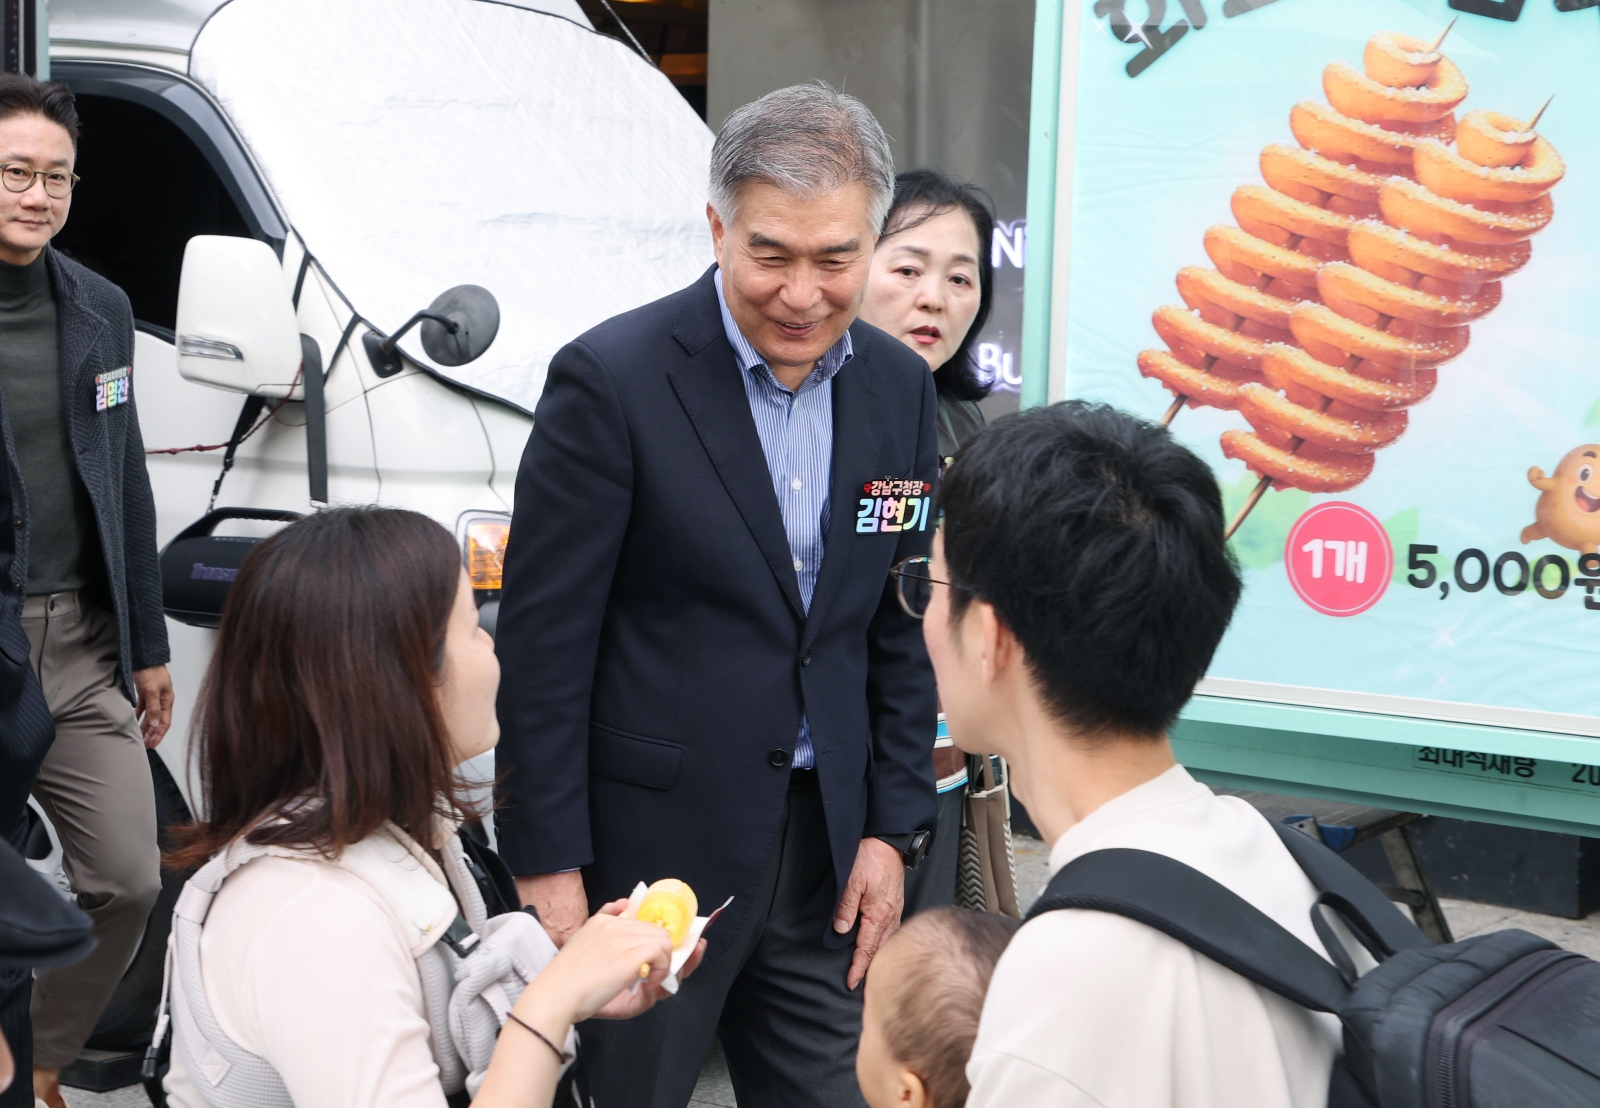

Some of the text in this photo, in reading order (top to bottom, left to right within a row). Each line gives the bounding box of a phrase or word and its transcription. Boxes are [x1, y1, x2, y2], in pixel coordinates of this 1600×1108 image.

[96, 376, 129, 412] 김명찬
[871, 480, 924, 496] 강남구청장
[856, 497, 931, 533] 김현기
[1301, 538, 1368, 584] 1개
